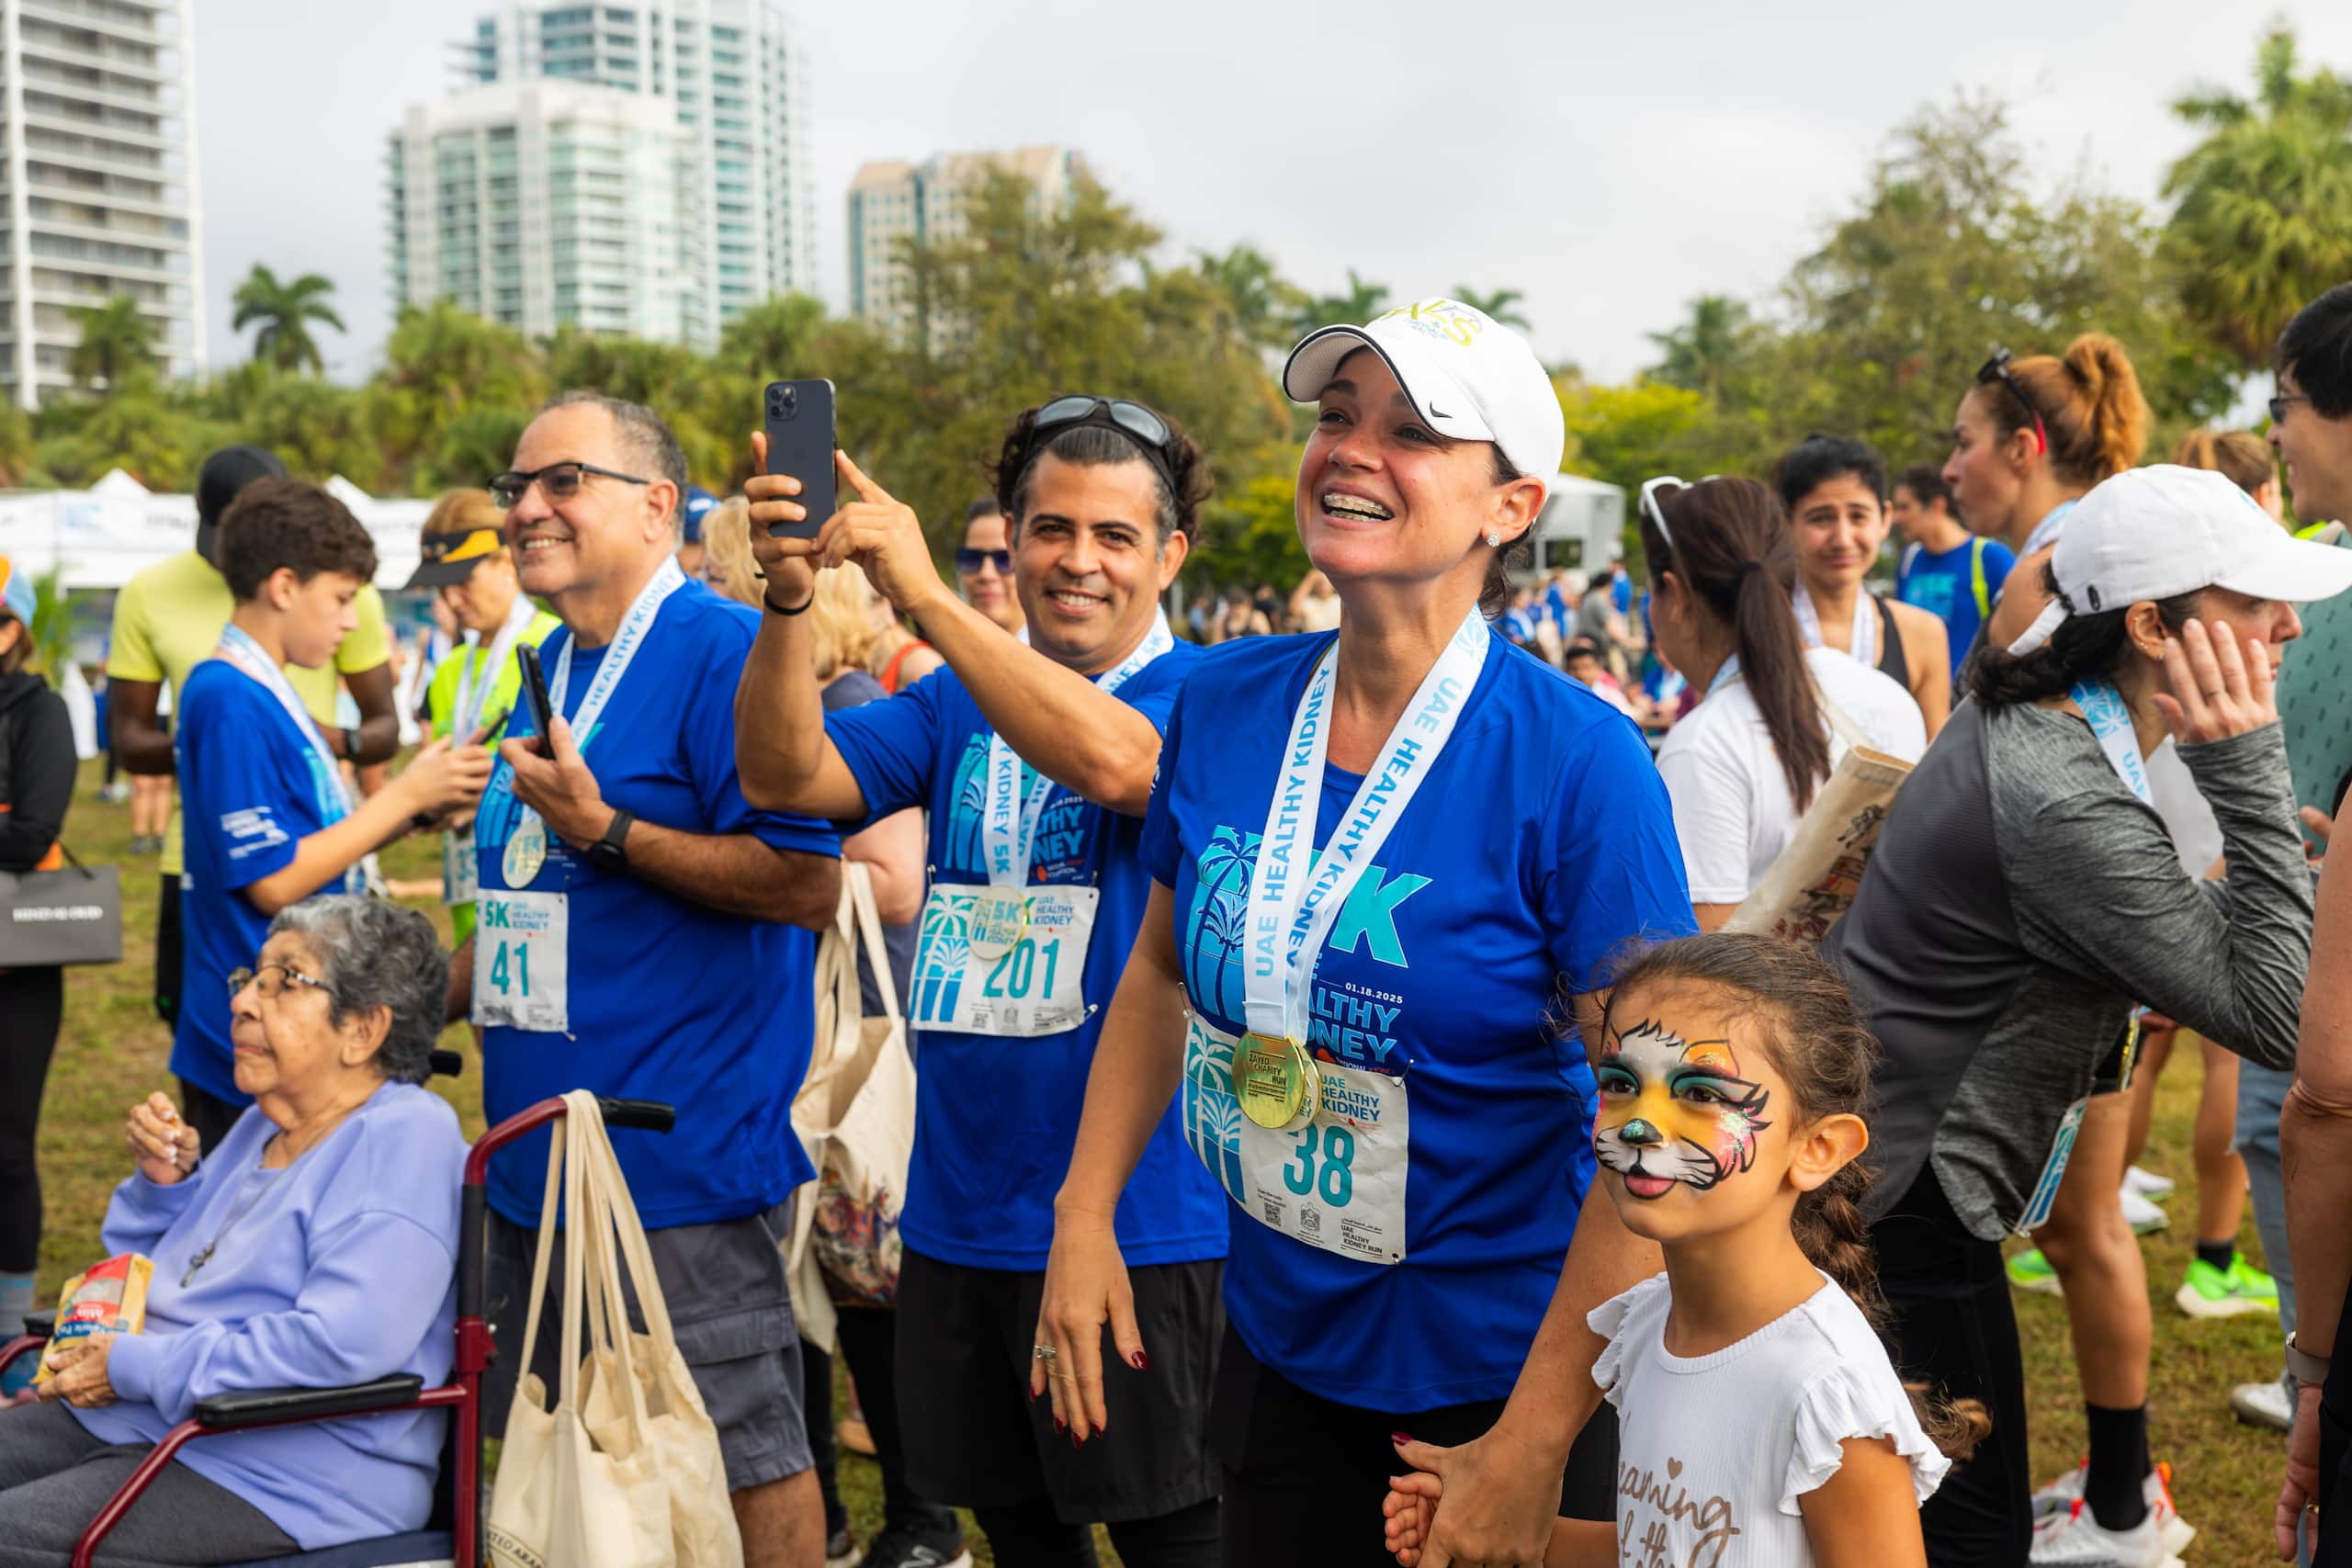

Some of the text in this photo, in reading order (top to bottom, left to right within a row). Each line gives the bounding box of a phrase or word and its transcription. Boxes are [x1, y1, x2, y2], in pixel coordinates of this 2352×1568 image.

[588, 626, 638, 706] HEALTHY
[992, 759, 1012, 874] KIDNEY 5K
[1035, 805, 1084, 837] LTHY
[1255, 668, 1330, 977] UAE HEALTHY KIDNEY
[1285, 676, 1464, 969] UAE HEALTHY KIDNEY
[1030, 829, 1085, 864] NEY
[485, 900, 511, 930] 5K
[992, 899, 1023, 924] 5K
[1033, 915, 1074, 927] KIDNEY
[1035, 905, 1075, 914] HEALTHY
[490, 941, 530, 998] 41
[982, 937, 1060, 1000] 201
[1345, 982, 1404, 1005] 01.18.2025
[1308, 986, 1402, 1034] LTHY
[1249, 1053, 1270, 1066] ZAYED
[1253, 1063, 1283, 1077] CHARITY
[1272, 1075, 1287, 1087] RUN
[1320, 1073, 1346, 1089] UAE
[1321, 1086, 1381, 1109] HEALTHY
[1321, 1097, 1382, 1122] KIDNEY
[1283, 1122, 1355, 1208] 38
[1340, 1224, 1355, 1235] UAE
[1342, 1231, 1370, 1246] HEALTHY
[1343, 1237, 1383, 1255] KIDNEY RUN
